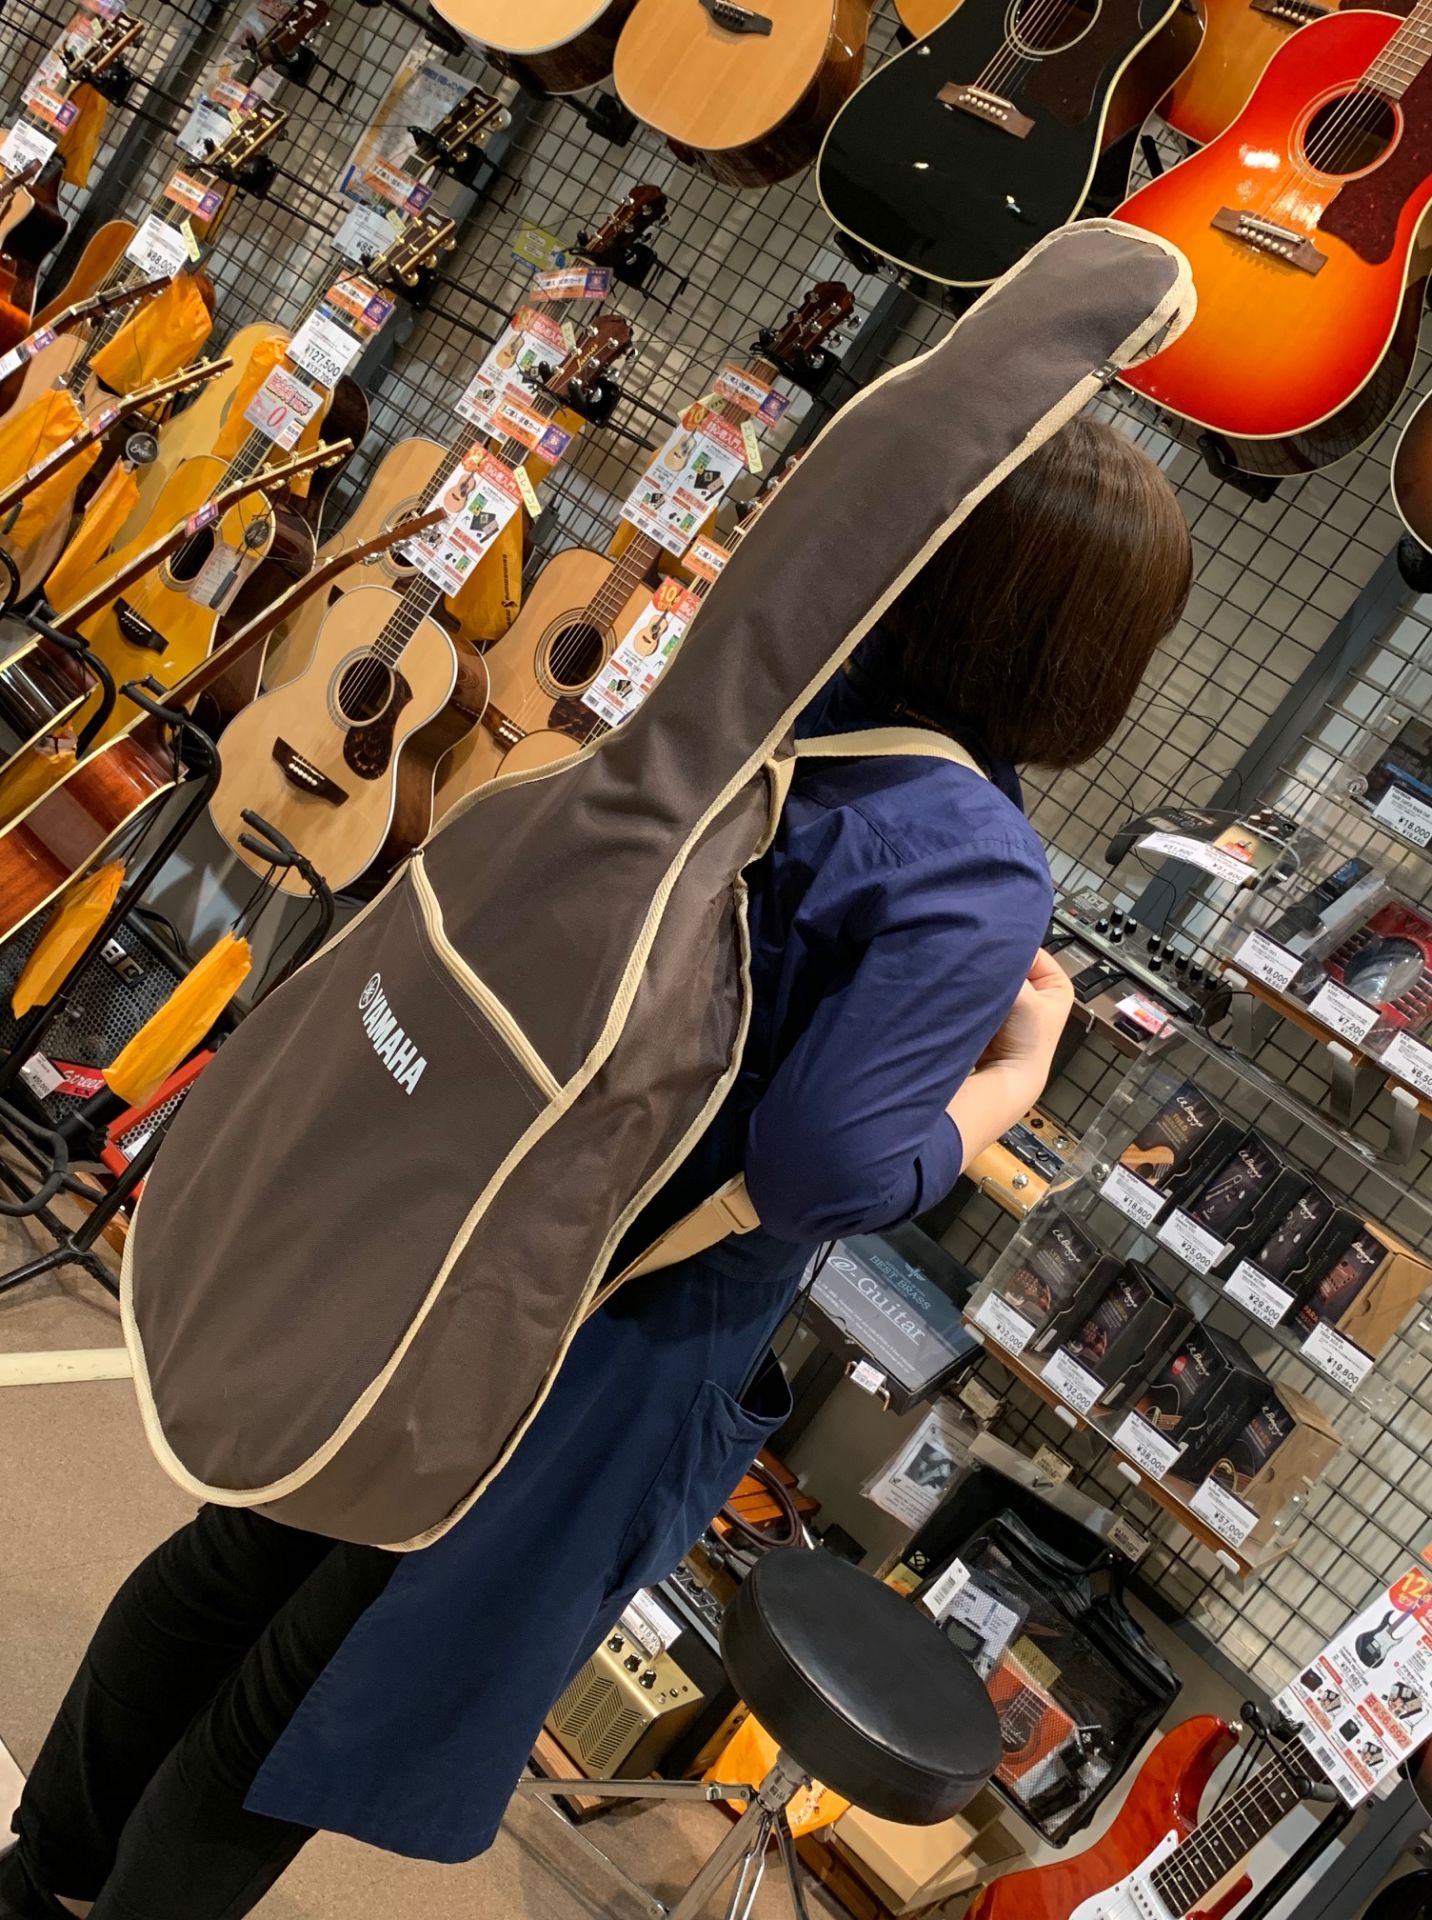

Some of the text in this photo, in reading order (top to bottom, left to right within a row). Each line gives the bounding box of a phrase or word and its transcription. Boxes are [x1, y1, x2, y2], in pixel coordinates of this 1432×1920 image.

[303, 343, 341, 377] ¥127,500
[1397, 815, 1431, 839] ¥18,000
[1262, 963, 1288, 984] ¥8,000
[1337, 1015, 1365, 1037] ¥7,200
[362, 988, 428, 1096] YAMAHA
[60, 1068, 104, 1089] Street
[1122, 1195, 1153, 1221] ¥18,800
[1180, 1240, 1211, 1267] ¥25,000
[868, 1253, 898, 1281] BEST
[896, 1277, 931, 1311] BRASS
[1248, 1293, 1280, 1320] ¥29,500
[995, 1322, 1024, 1349] ¥32,000
[1326, 1355, 1359, 1384] ¥19,800
[1062, 1380, 1091, 1407] ¥32,000
[1135, 1444, 1166, 1473] ¥38,000
[1213, 1510, 1245, 1540] ¥57,000
